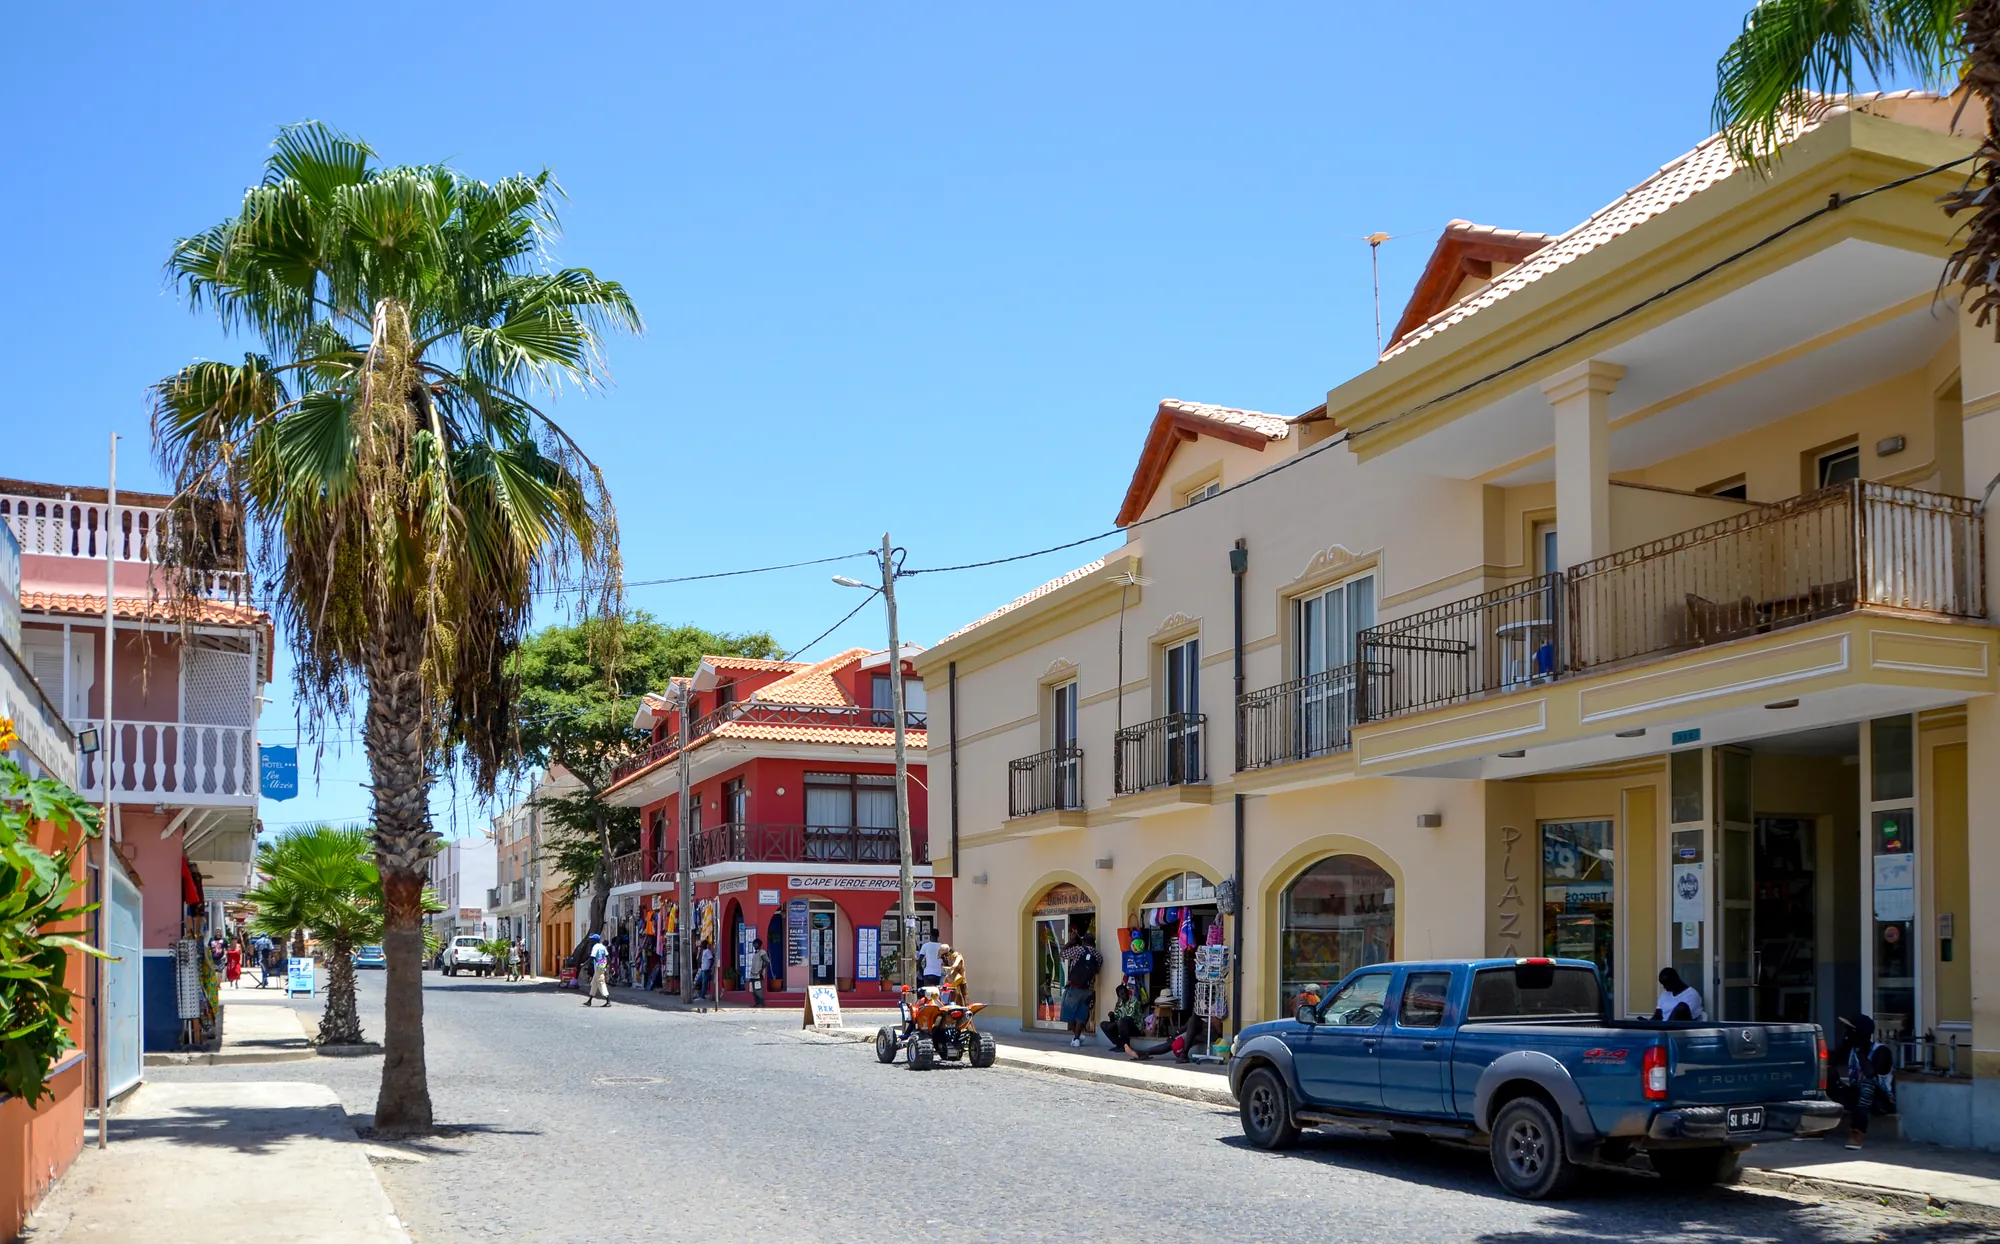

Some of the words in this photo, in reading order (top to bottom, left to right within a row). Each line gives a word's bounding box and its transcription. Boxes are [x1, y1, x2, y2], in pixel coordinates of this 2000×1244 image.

[804, 877, 834, 887] CAPE
[834, 878, 867, 888] VERDE
[868, 879, 921, 889] PROPEY
[1697, 1071, 1793, 1085] FRONTIER
[1730, 1114, 1738, 1127] SL
